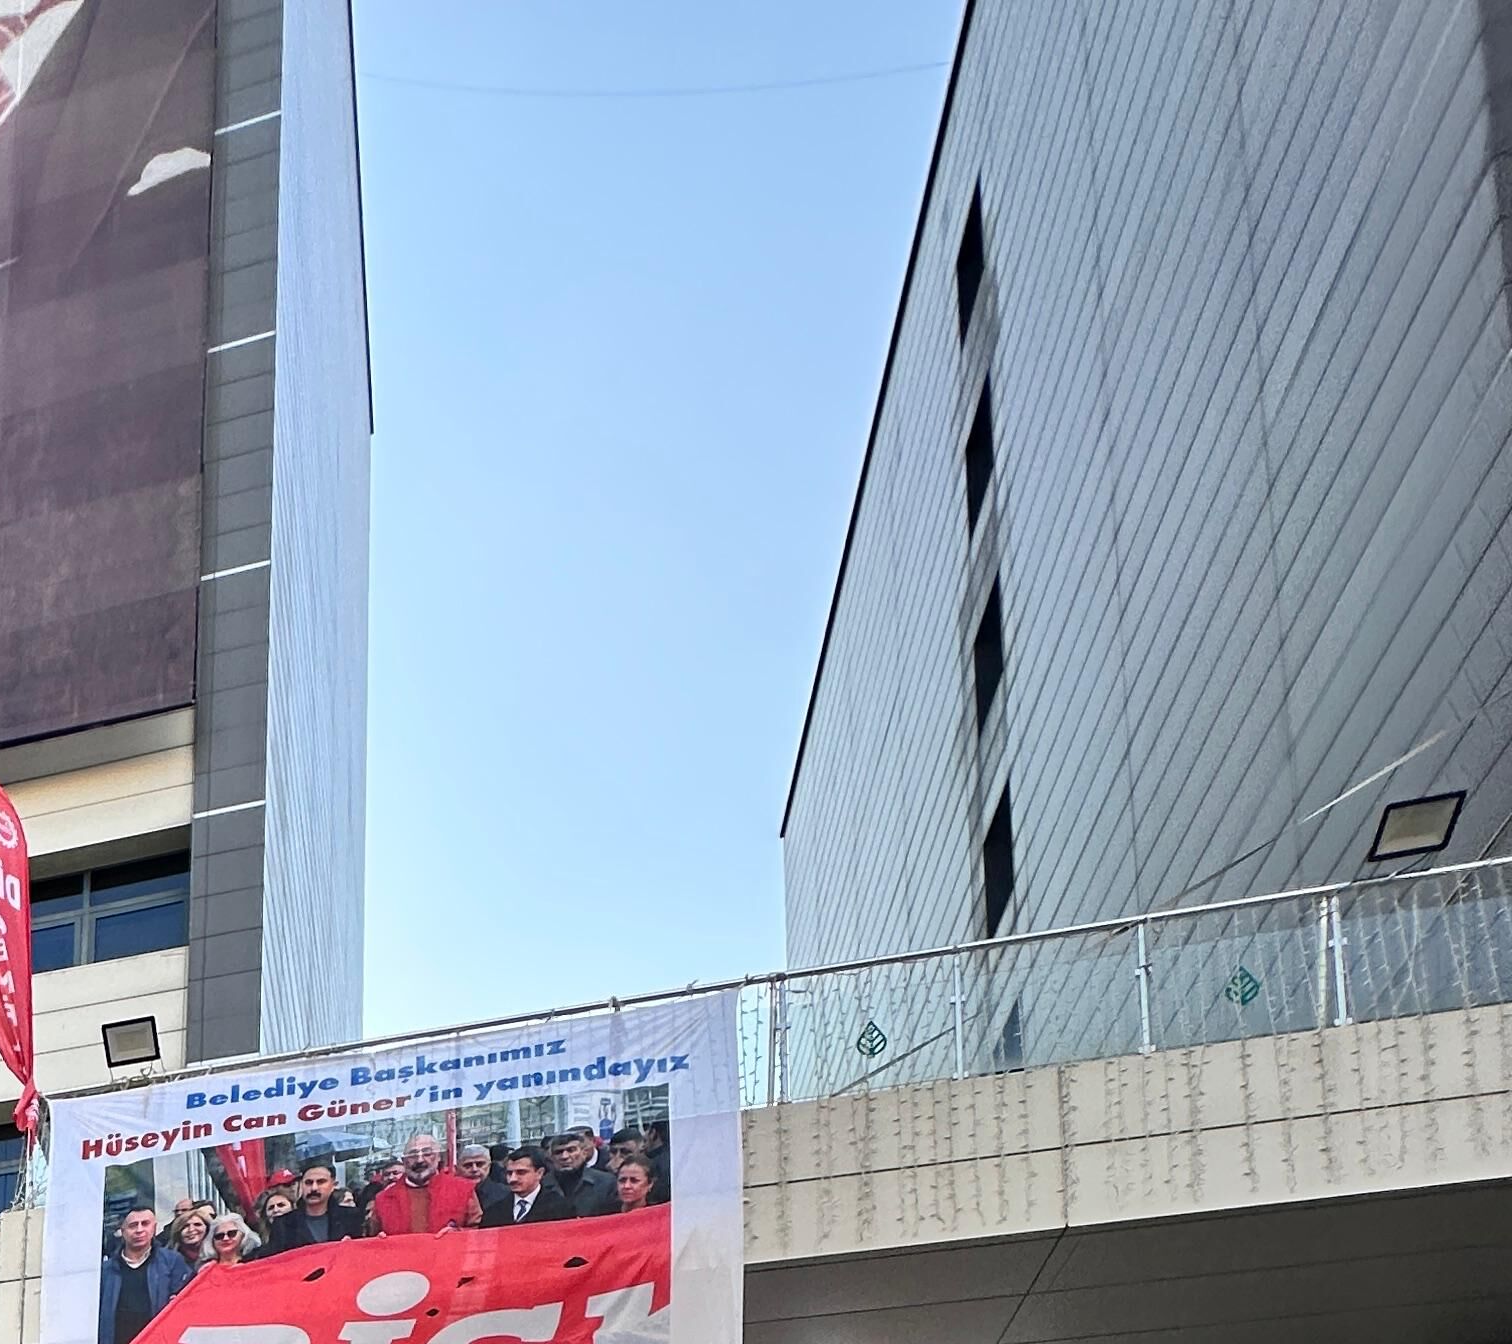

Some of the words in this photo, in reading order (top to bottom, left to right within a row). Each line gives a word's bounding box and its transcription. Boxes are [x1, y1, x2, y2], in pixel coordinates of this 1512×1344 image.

[81, 1119, 212, 1161] Hüseyin
[222, 1111, 287, 1134] Can
[474, 1053, 690, 1102] yanındayız
[185, 1073, 340, 1111] Belediye
[350, 1038, 567, 1086] Başkanımız
